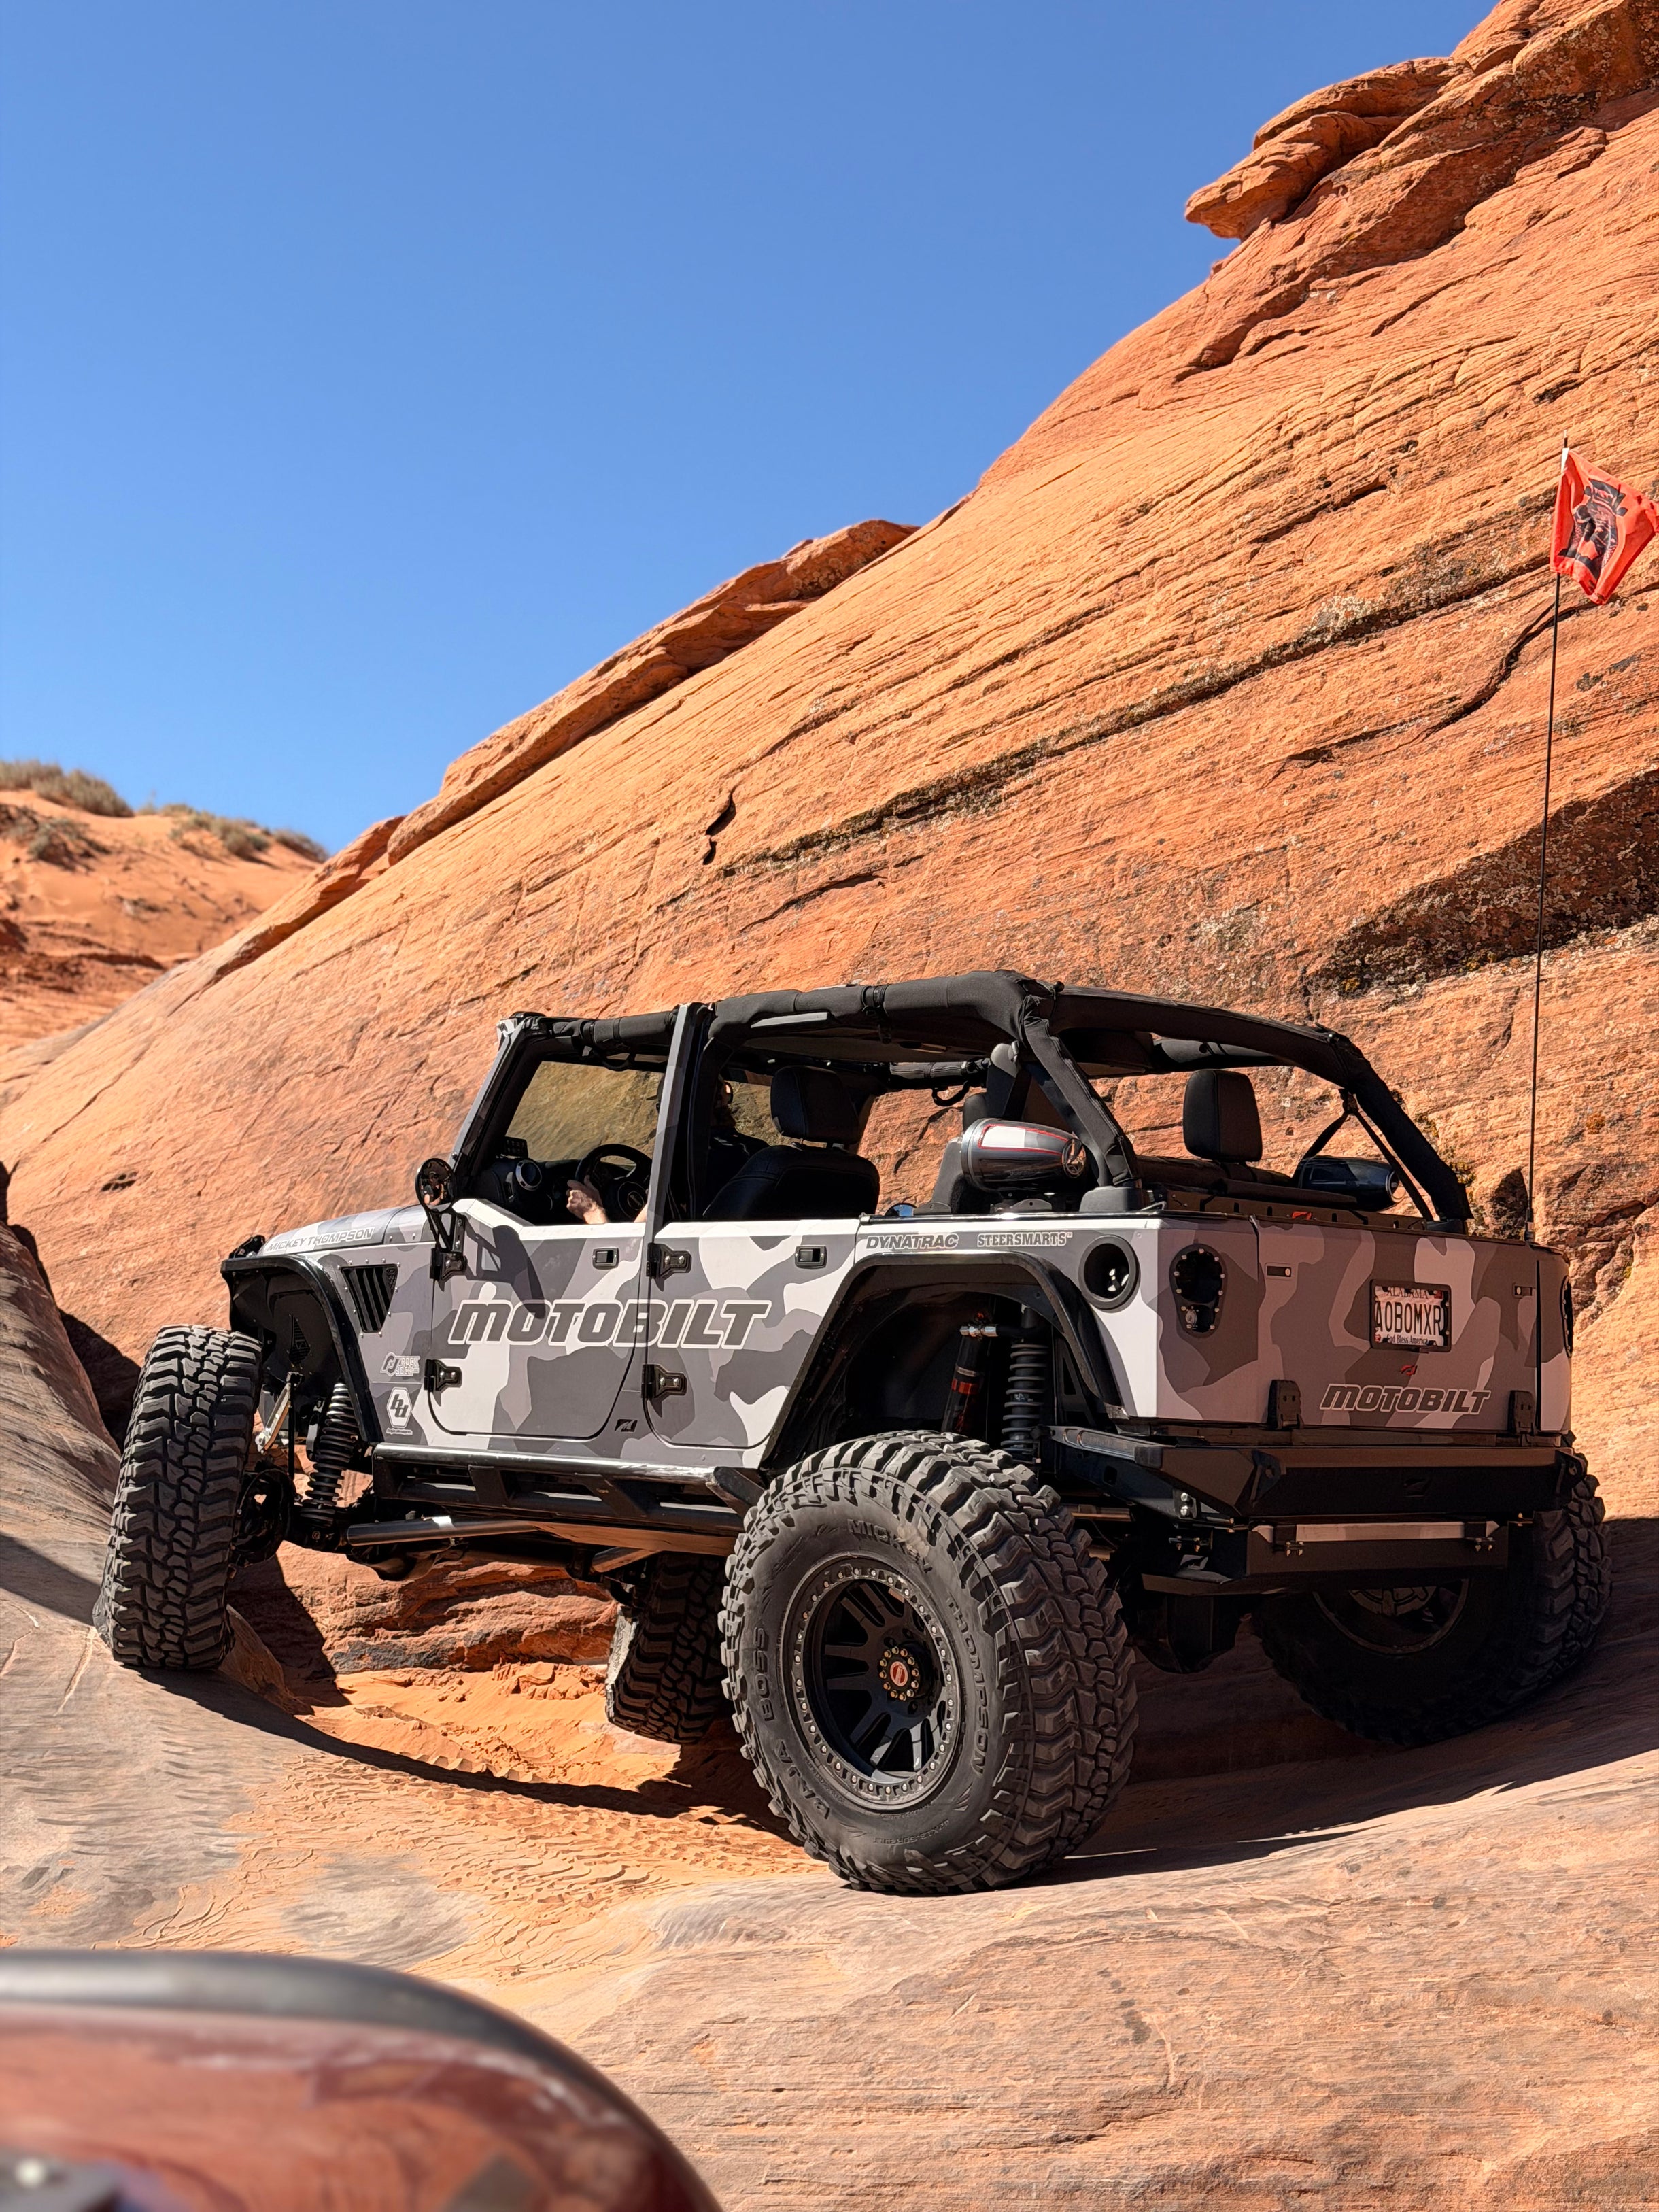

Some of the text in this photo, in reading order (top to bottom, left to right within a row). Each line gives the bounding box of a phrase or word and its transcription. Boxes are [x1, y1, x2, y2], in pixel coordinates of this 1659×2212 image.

[267, 1227, 375, 1251] MICKEY THOMPSON
[866, 1233, 959, 1249] DYNATRAC
[447, 1299, 772, 1349] MOTOBILT
[1397, 1334, 1409, 1344] Bless
[1410, 1335, 1428, 1346] America
[1320, 1384, 1491, 1415] MOTOBILT
